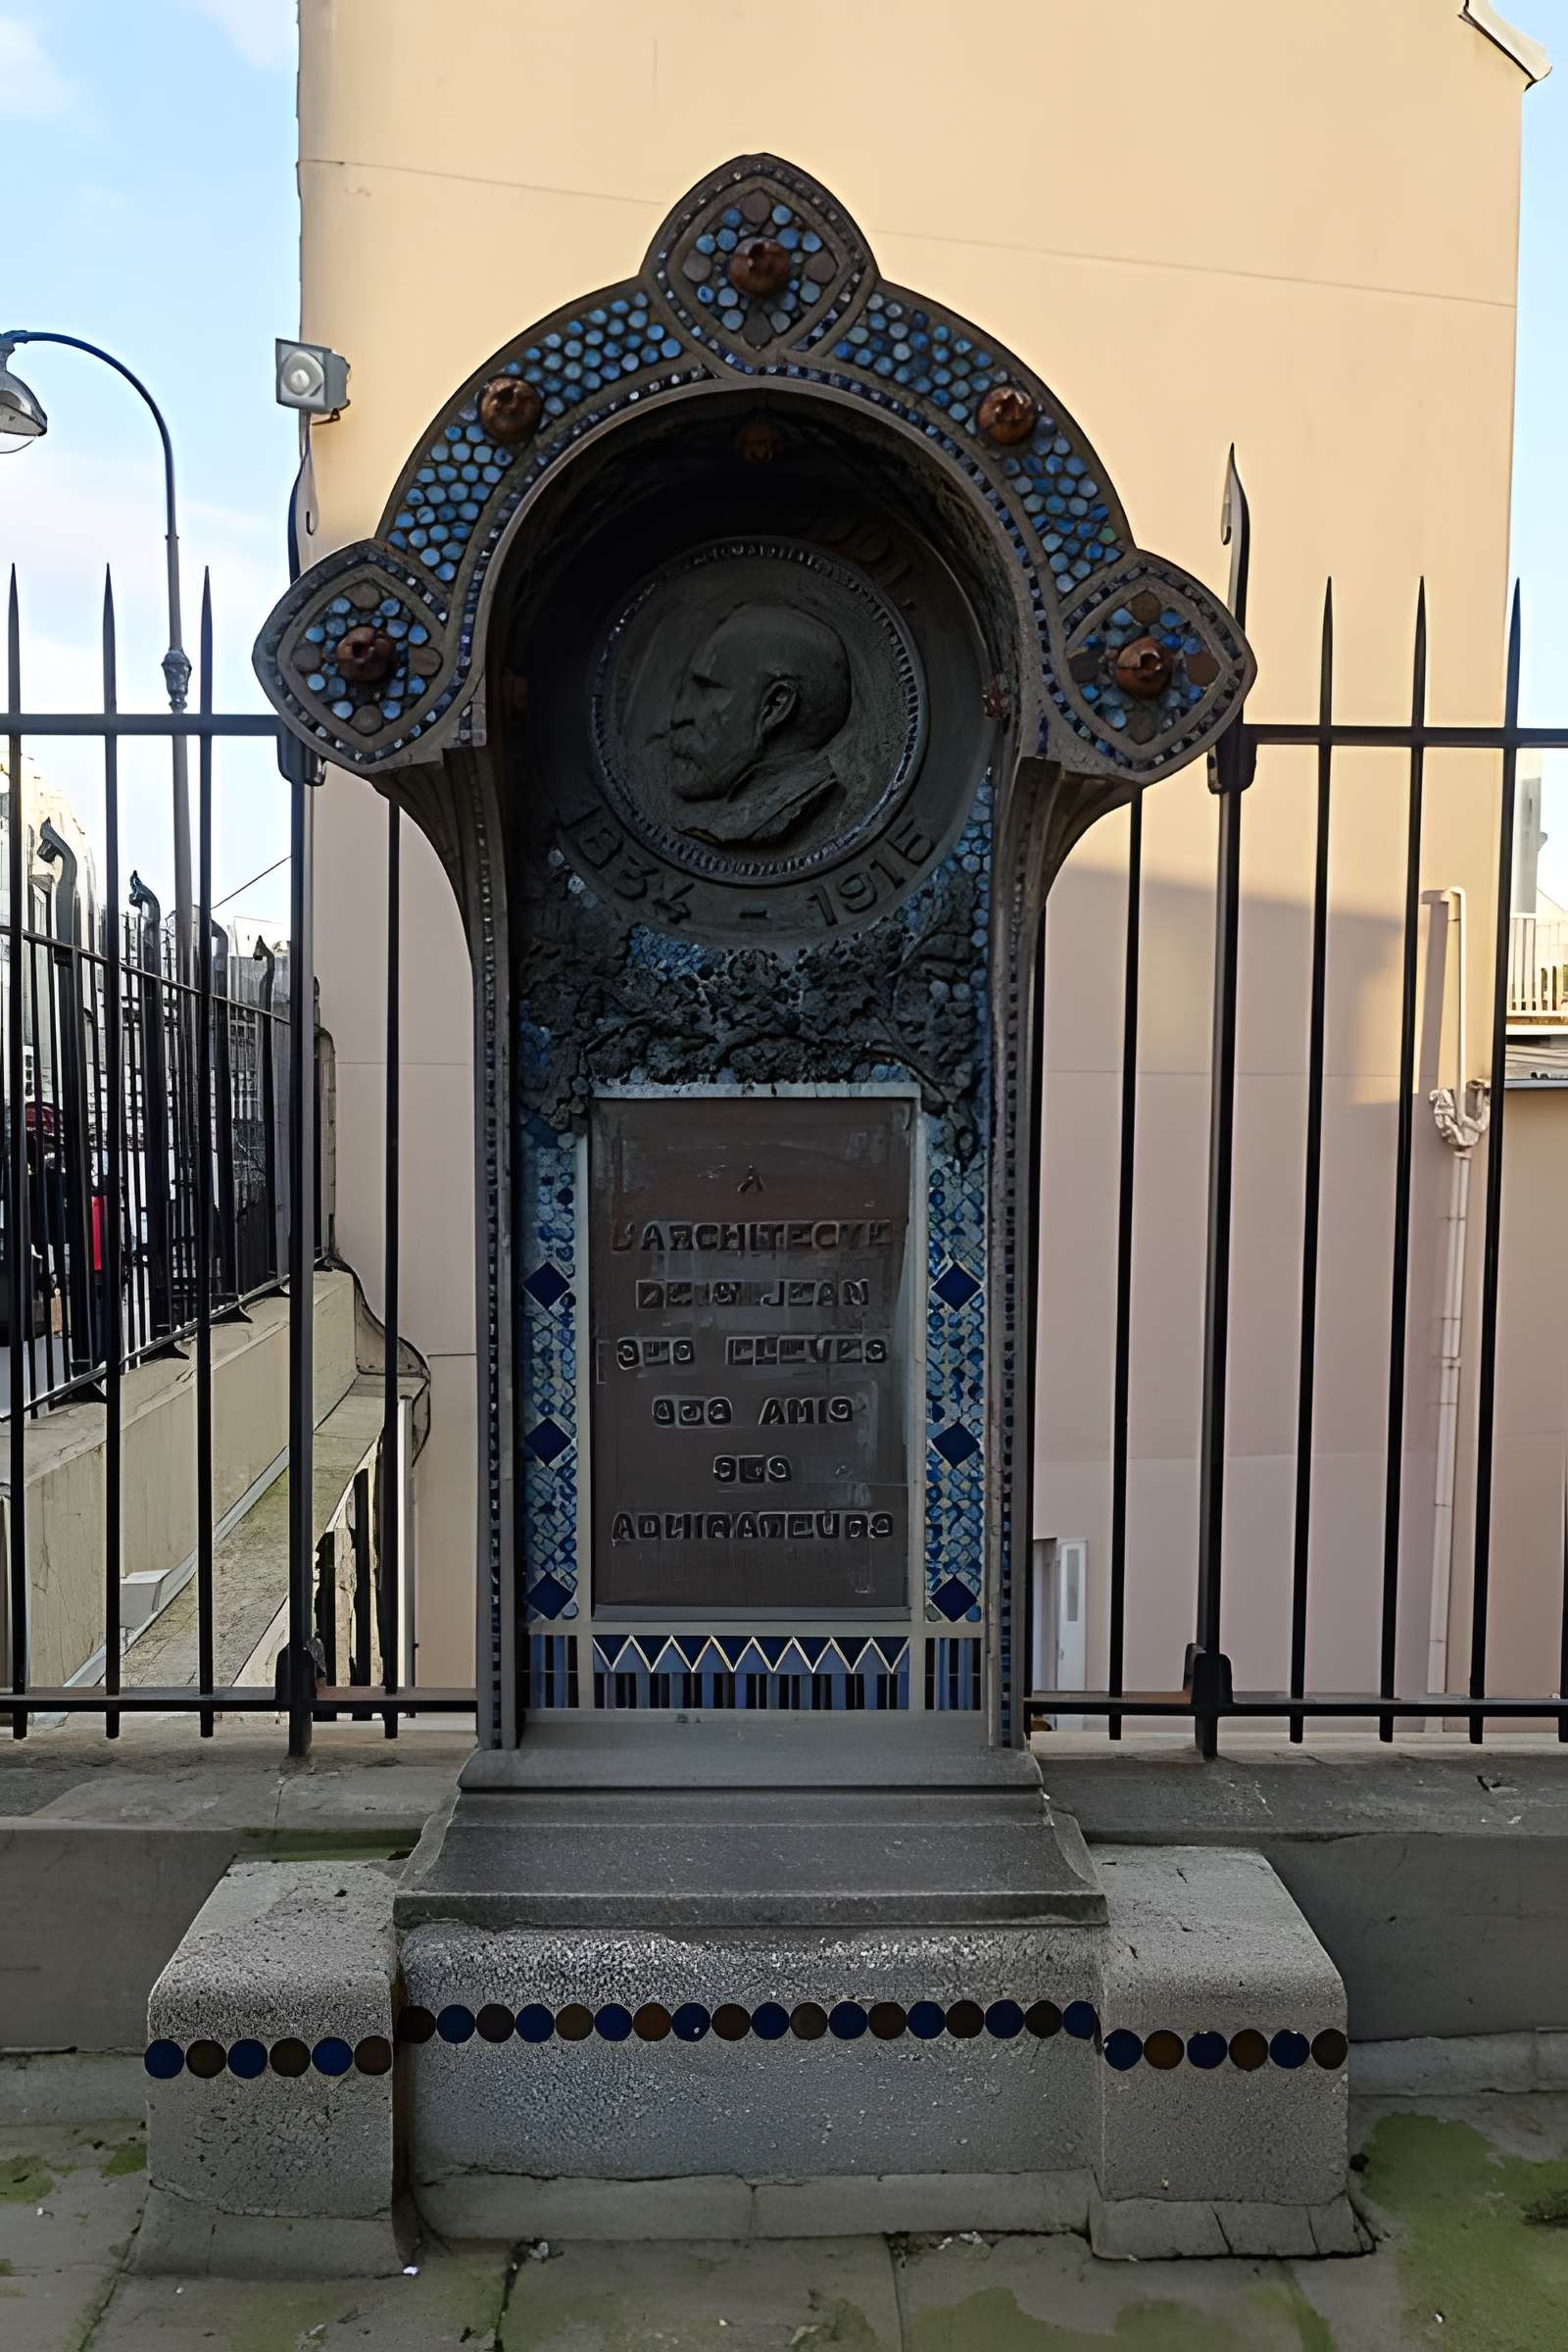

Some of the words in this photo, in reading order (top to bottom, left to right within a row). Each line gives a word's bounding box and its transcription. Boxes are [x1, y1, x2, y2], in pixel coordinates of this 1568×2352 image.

[808, 817, 936, 927] 1915
[760, 1279, 870, 1306] JEAN
[759, 1396, 853, 1426] AMIS
